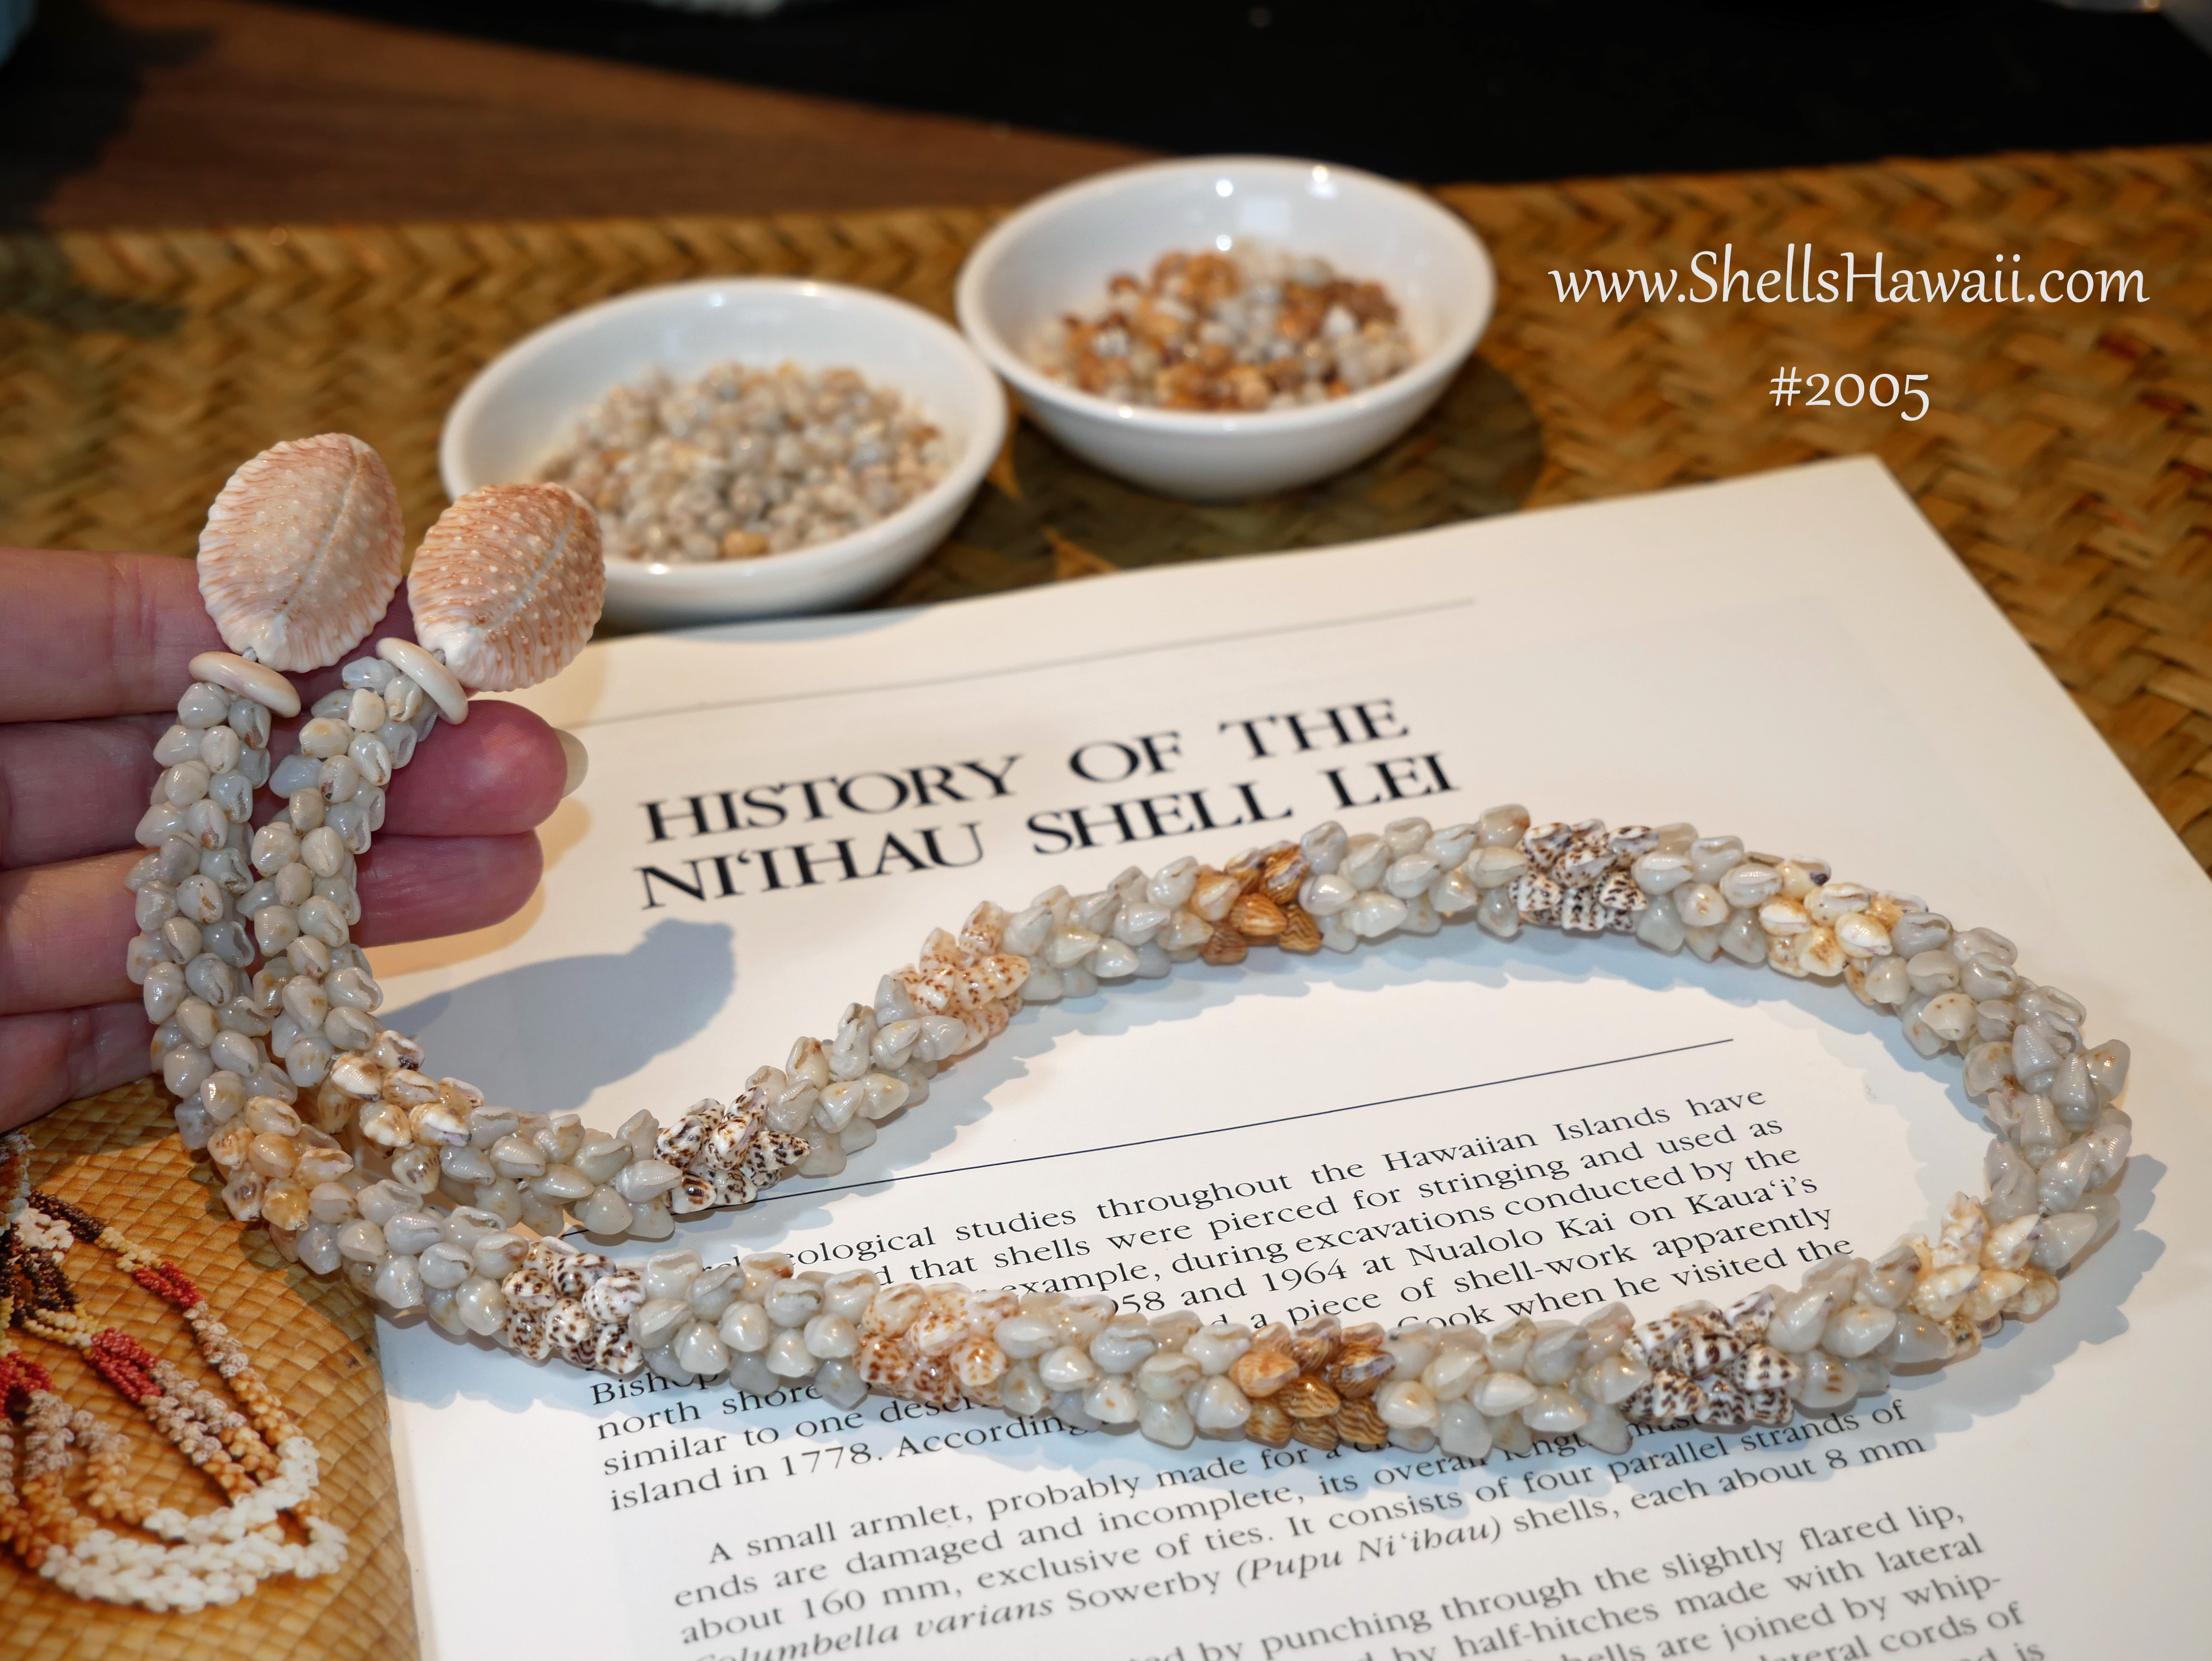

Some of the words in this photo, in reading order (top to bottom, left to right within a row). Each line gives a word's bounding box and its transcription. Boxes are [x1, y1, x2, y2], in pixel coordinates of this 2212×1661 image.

[638, 755, 1024, 843] HISTORY
[1068, 731, 1182, 784] OF
[1219, 699, 1409, 761] THE
[1026, 781, 1293, 855] SHELL
[1317, 751, 1462, 812] LEI
[910, 1254, 978, 1281] that
[994, 1238, 1091, 1269] shells
[1106, 1225, 1193, 1250] were
[1208, 1196, 1339, 1240] pierced
[1353, 1187, 1401, 1211] for
[1418, 1157, 1569, 1199] stringing
[1580, 1141, 1644, 1171] and
[1656, 1125, 1737, 1155] used
[1749, 1118, 1783, 1138] as
[956, 1210, 1076, 1241] studies
[1096, 1174, 1292, 1219] throughout
[1311, 1159, 1365, 1185] the
[1381, 1132, 1539, 1172] Hawaiian
[1553, 1106, 1671, 1142] Islands
[1685, 1089, 1766, 1118] have
[1172, 1240, 1288, 1275] during
[1295, 1203, 1495, 1253] excavations
[1504, 1167, 1686, 1216] conducted
[1692, 1161, 1734, 1183] by
[1745, 1147, 1801, 1173] the
[1181, 1277, 1248, 1306] and
[1262, 1258, 1348, 1292] 1964
[1362, 1253, 1396, 1276] at
[1408, 1227, 1543, 1268] Nualolo
[1555, 1213, 1616, 1241] Kai
[1629, 1206, 1676, 1227] on
[1251, 1314, 1267, 1329] a
[1286, 1293, 1382, 1326] piece
[1400, 1277, 1437, 1303] of
[1456, 1243, 1638, 1293] shell-work
[1652, 1208, 1833, 1258] apparently
[1503, 1286, 1604, 1321] when
[1613, 1273, 1660, 1298] he
[1671, 1248, 1788, 1287] visited
[1796, 1240, 1854, 1262] the
[597, 1402, 700, 1440] north
[603, 1434, 728, 1476] similar
[744, 1424, 779, 1447] to
[794, 1411, 864, 1438] one
[610, 1469, 723, 1512] island
[732, 1463, 770, 1486] in
[780, 1442, 884, 1476] 1778.
[674, 1575, 759, 1608] ends
[774, 1562, 829, 1589] are
[845, 1529, 1004, 1575] damaged
[1017, 1516, 1085, 1546] and
[1099, 1483, 1305, 1534] incomplete,
[1317, 1471, 1359, 1496] its
[680, 1607, 785, 1644] about
[802, 1588, 867, 1620] 160
[882, 1576, 962, 1606] mm,
[977, 1545, 1142, 1590] exclusive
[1156, 1533, 1193, 1559] of
[1204, 1526, 1274, 1551] ties.
[1287, 1516, 1316, 1538] It
[1329, 1484, 1463, 1530] consists
[1475, 1476, 1511, 1503] of
[1523, 1464, 1594, 1494] four
[1609, 1436, 1730, 1484] parallel
[1740, 1411, 1860, 1453] strands
[1871, 1398, 1909, 1426] of
[709, 1543, 733, 1565] A
[747, 1521, 837, 1557] small
[850, 1503, 974, 1539] armlet,
[987, 1474, 1141, 1522] probably
[1156, 1457, 1248, 1488] made
[1261, 1449, 1308, 1470] for
[915, 1596, 1053, 1638] varians
[1066, 1569, 1222, 1612] Sowerby
[1236, 1549, 1343, 1588] (Pupu
[1513, 1496, 1620, 1533] shells,
[1631, 1473, 1711, 1510] each
[1718, 1457, 1818, 1493] about
[1827, 1448, 1849, 1470] 8
[1859, 1436, 1928, 1465] mm
[1261, 1606, 1433, 1660] punching
[1440, 1577, 1583, 1621] through
[1593, 1566, 1651, 1592] the
[1661, 1538, 1784, 1580] slightly
[1799, 1511, 1900, 1552] flared
[1907, 1503, 1965, 1530] lip,
[1454, 1601, 1659, 1659] half-hitches
[1675, 1579, 1770, 1616] made
[1784, 1559, 1866, 1592] with
[1875, 1531, 1986, 1573] lateral
[1656, 1632, 1712, 1660] are
[1720, 1602, 1836, 1652] joined
[1842, 1595, 1888, 1620] by
[1901, 1573, 2002, 1600] whip-
[1879, 1615, 1978, 1653] cords
[1987, 1600, 2026, 1630] of
